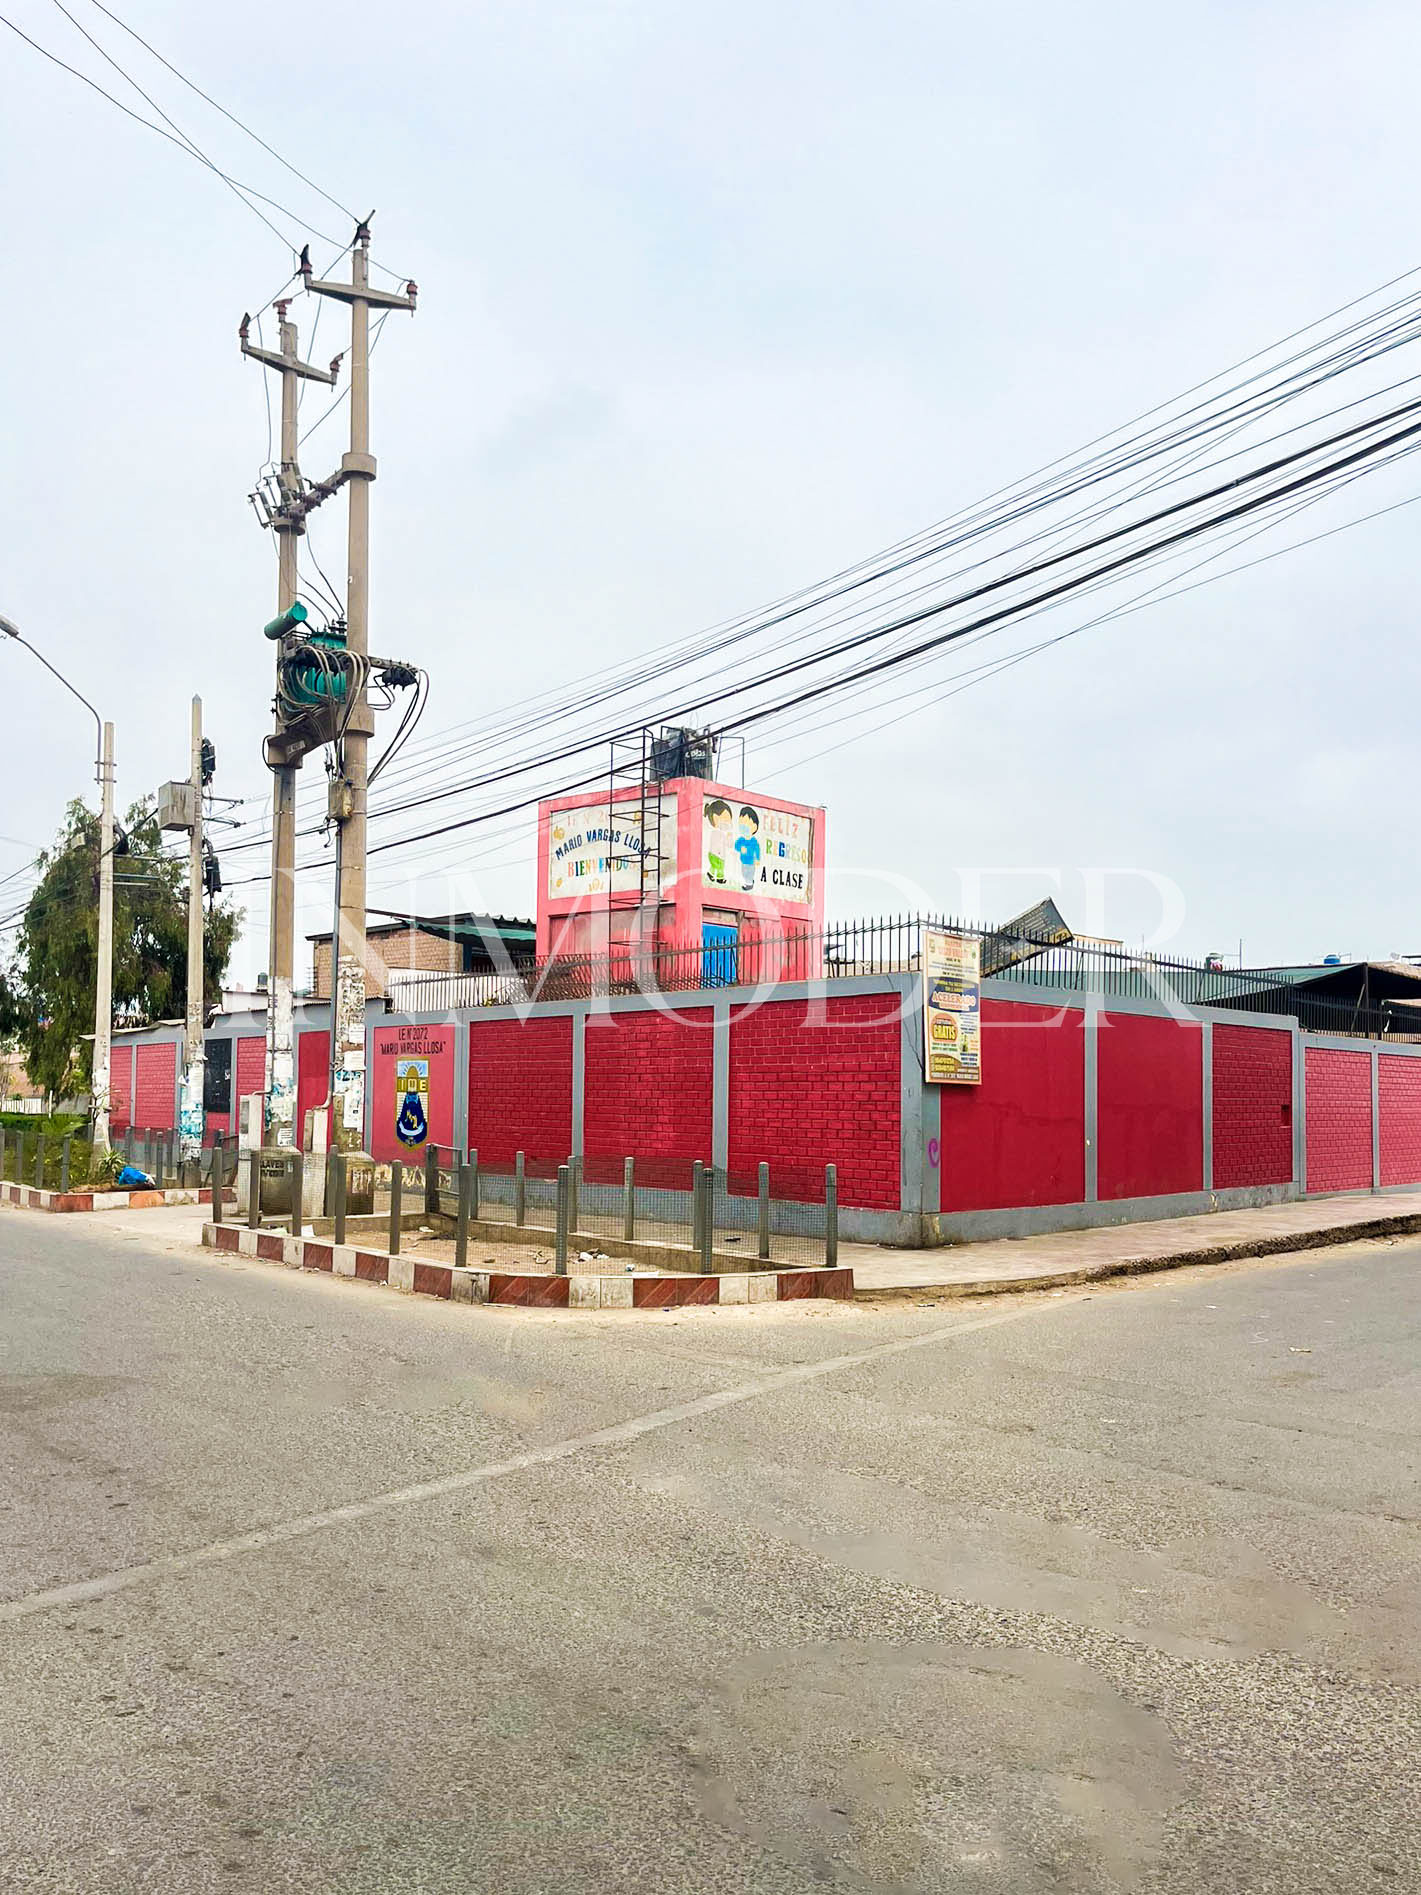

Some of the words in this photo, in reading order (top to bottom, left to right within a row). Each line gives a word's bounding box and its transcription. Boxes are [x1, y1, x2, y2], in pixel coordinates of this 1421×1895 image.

[555, 834, 583, 860] MARIO
[586, 828, 621, 843] VARGAS
[623, 833, 652, 859] LLOA
[760, 866, 767, 883] A
[772, 868, 804, 889] CLASE
[933, 1024, 956, 1041] GRATIS
